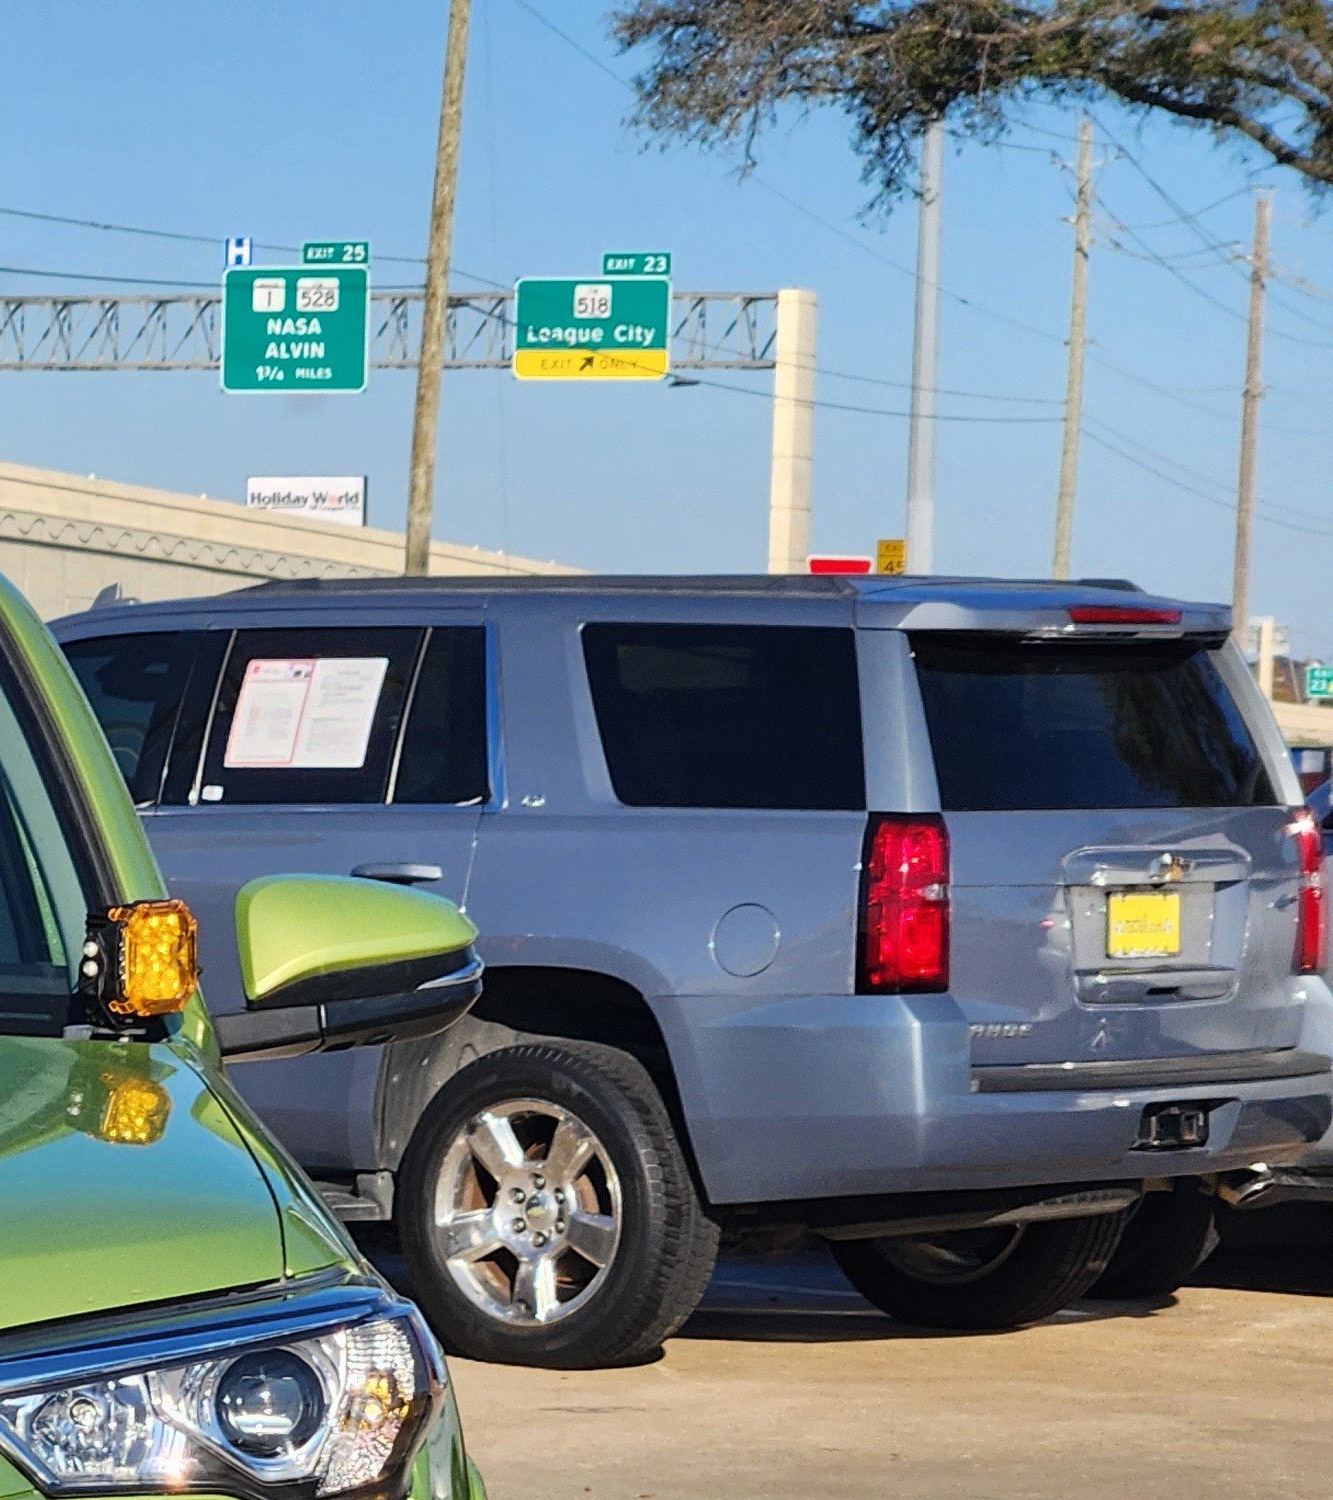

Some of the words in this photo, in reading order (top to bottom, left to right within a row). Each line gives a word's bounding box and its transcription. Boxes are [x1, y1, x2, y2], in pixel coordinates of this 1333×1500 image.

[228, 238, 250, 265] H
[306, 247, 335, 260] EXIT
[342, 245, 366, 262] 25
[606, 258, 636, 271] EXIT
[643, 256, 667, 273] 23
[300, 290, 335, 309] 528
[577, 297, 609, 315] 518
[266, 318, 322, 335] NASA
[526, 325, 604, 346] League
[613, 324, 656, 347] City
[265, 341, 325, 359] ALVIN
[540, 358, 572, 370] EXIT
[599, 358, 639, 370] ONLY
[295, 367, 333, 380] MILES
[250, 491, 309, 507] Holiday
